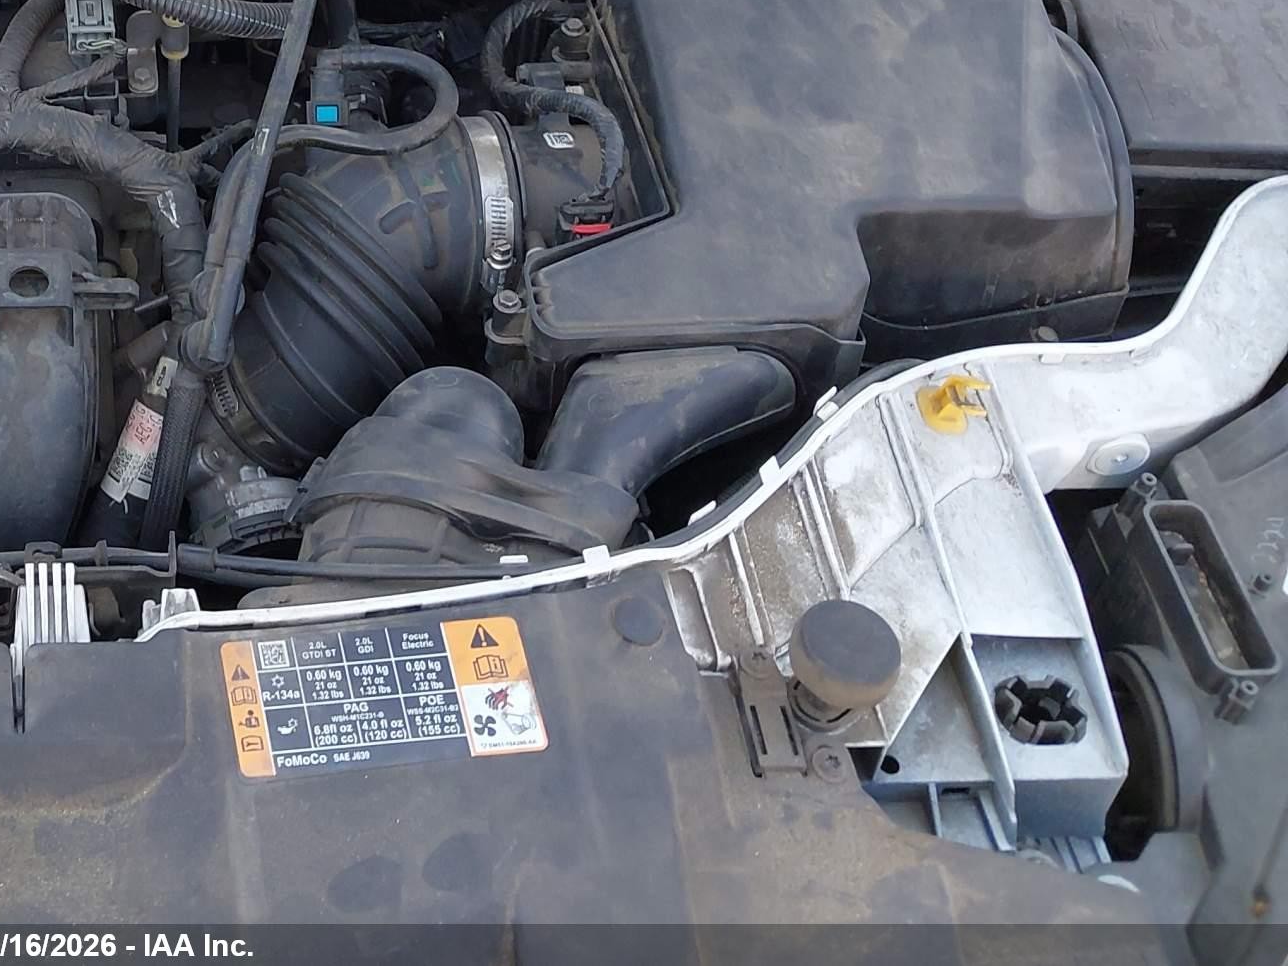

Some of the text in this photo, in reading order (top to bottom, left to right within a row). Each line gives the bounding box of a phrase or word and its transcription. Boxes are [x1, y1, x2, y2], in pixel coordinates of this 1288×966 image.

[354, 636, 374, 646] 2.0L
[402, 633, 429, 642] Focus
[308, 641, 327, 650] 2.0L
[401, 640, 434, 650] Electric
[325, 648, 337, 658] ST
[353, 664, 389, 676] 0.60 kg
[405, 659, 441, 672] 0.60 kg
[306, 668, 342, 682] 0.60 kg
[414, 672, 437, 682] 21 oz
[314, 682, 325, 691] 21
[361, 677, 384, 686] 21 oz
[411, 680, 444, 691] 1.32 lbs
[263, 689, 301, 702] R-134a
[312, 690, 344, 701] 1.32 lbs
[359, 685, 392, 696] 1.32 lbs
[418, 694, 445, 707] POE
[343, 702, 369, 714] PAG
[362, 719, 404, 731] 4.0 fl oz
[415, 714, 457, 726] 5.2 fl oz
[339, 724, 353, 733] oz
[418, 723, 461, 738] (155 cc)
[315, 732, 358, 748] (200 cc)
[364, 727, 408, 743] (120 cc)
[276, 753, 327, 768] FoMoCo
[332, 750, 371, 762] SAE J639
